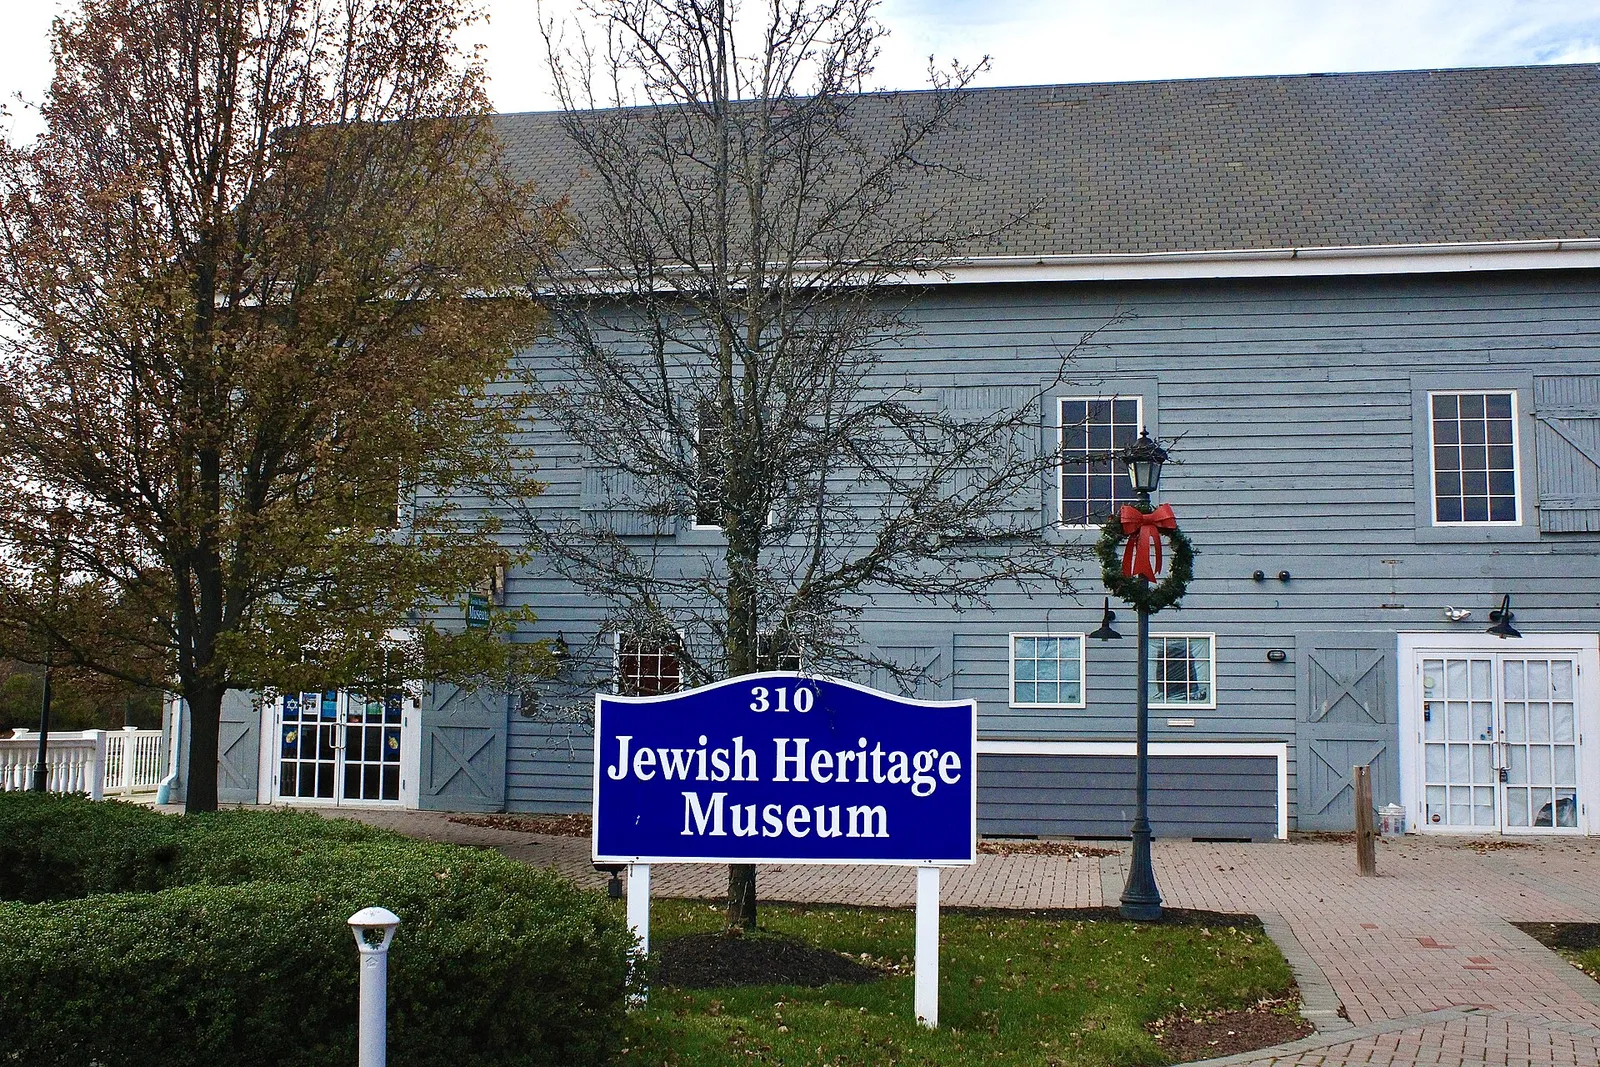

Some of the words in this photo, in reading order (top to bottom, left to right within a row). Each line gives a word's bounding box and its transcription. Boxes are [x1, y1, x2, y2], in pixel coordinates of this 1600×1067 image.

[749, 686, 814, 713] 310
[607, 735, 760, 782] Jewish
[772, 736, 962, 797] Heritage
[680, 791, 890, 838] Museum
